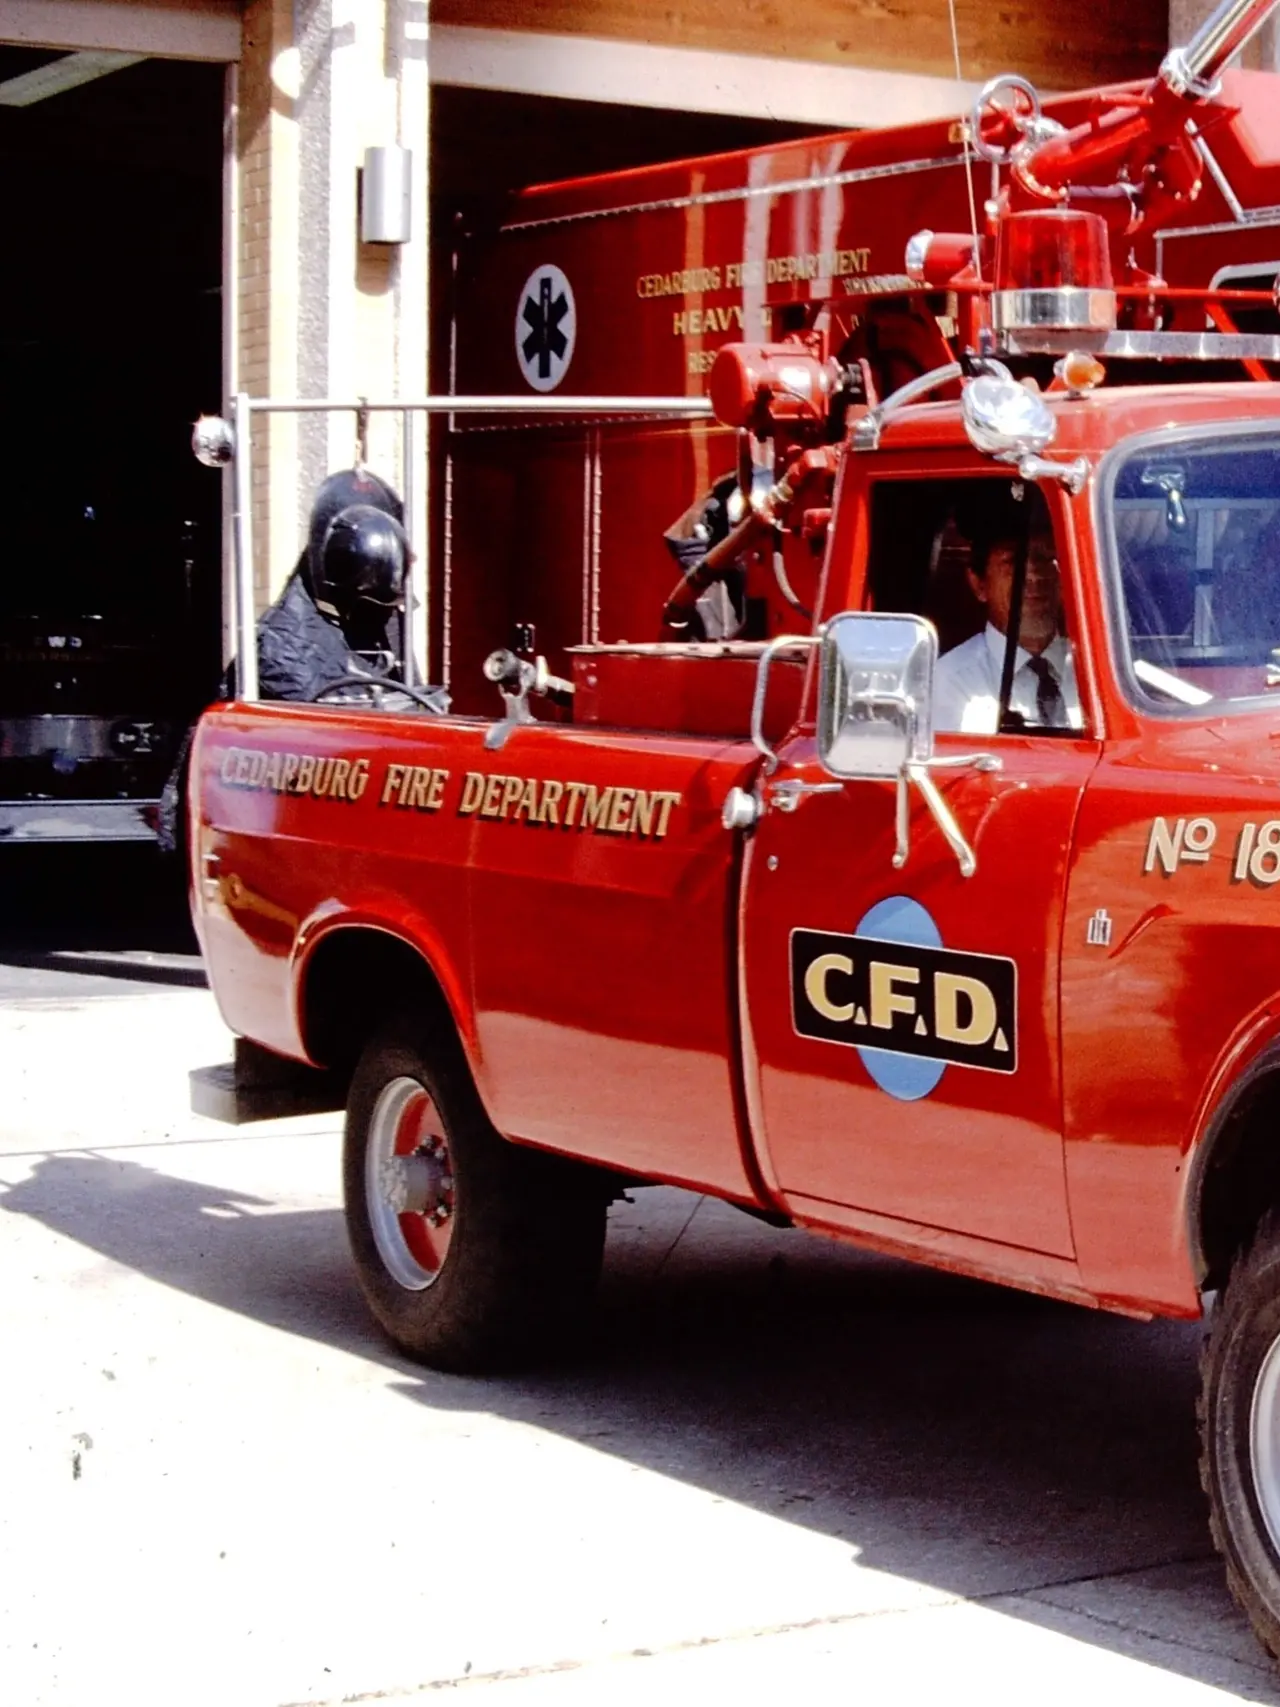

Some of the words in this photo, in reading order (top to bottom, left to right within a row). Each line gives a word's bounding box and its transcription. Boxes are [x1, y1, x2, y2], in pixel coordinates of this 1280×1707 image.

[636, 265, 722, 299] CEDARBURG
[725, 260, 765, 289] FI
[672, 305, 744, 336] HEAVY
[687, 350, 718, 374] RES
[220, 746, 370, 800] CEDARBURG
[381, 763, 450, 810] FIRE
[457, 771, 682, 838] DEPARTMENT
[804, 952, 1011, 1052] C.F.D.
